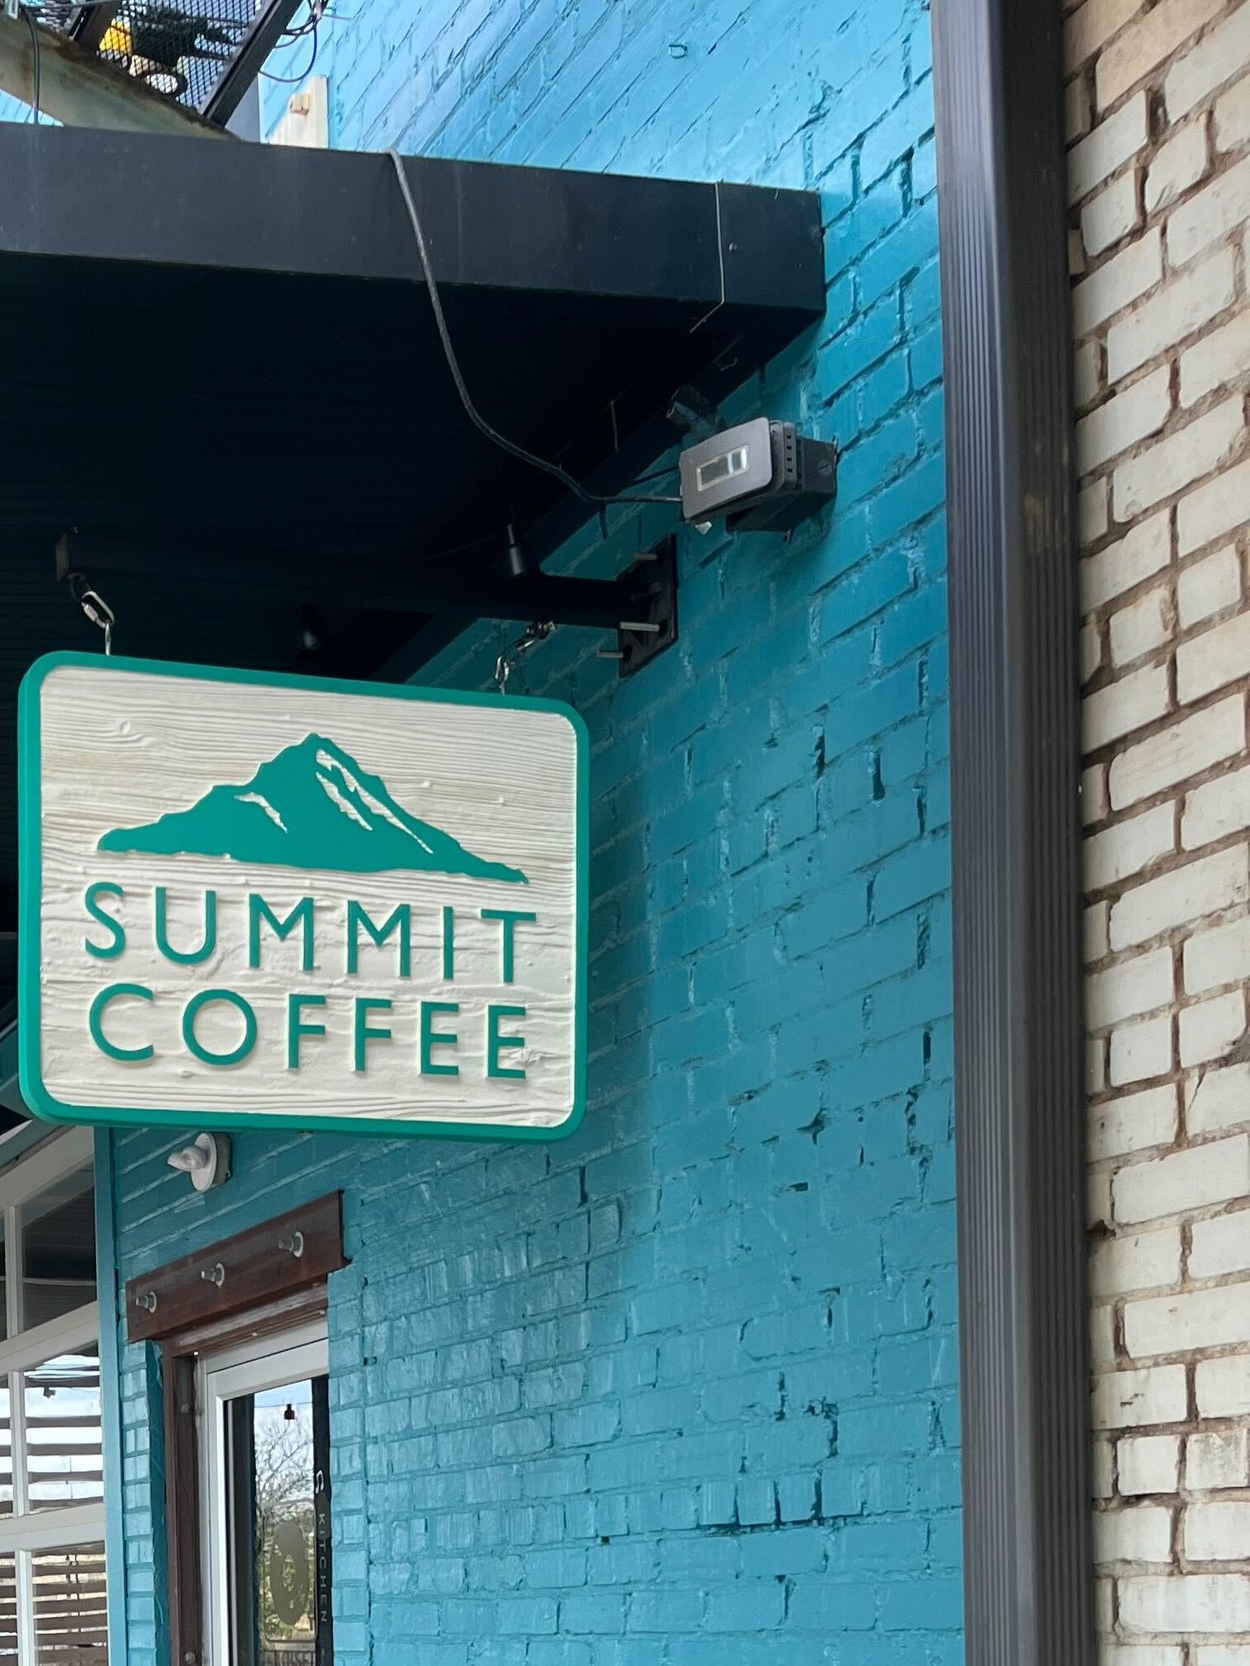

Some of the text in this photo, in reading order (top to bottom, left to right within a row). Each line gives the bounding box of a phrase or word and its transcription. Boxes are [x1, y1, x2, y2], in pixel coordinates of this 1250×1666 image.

[84, 881, 537, 984] SUMMIT
[89, 982, 527, 1080] COFFEE
[318, 1513, 328, 1622] KITCHEN
